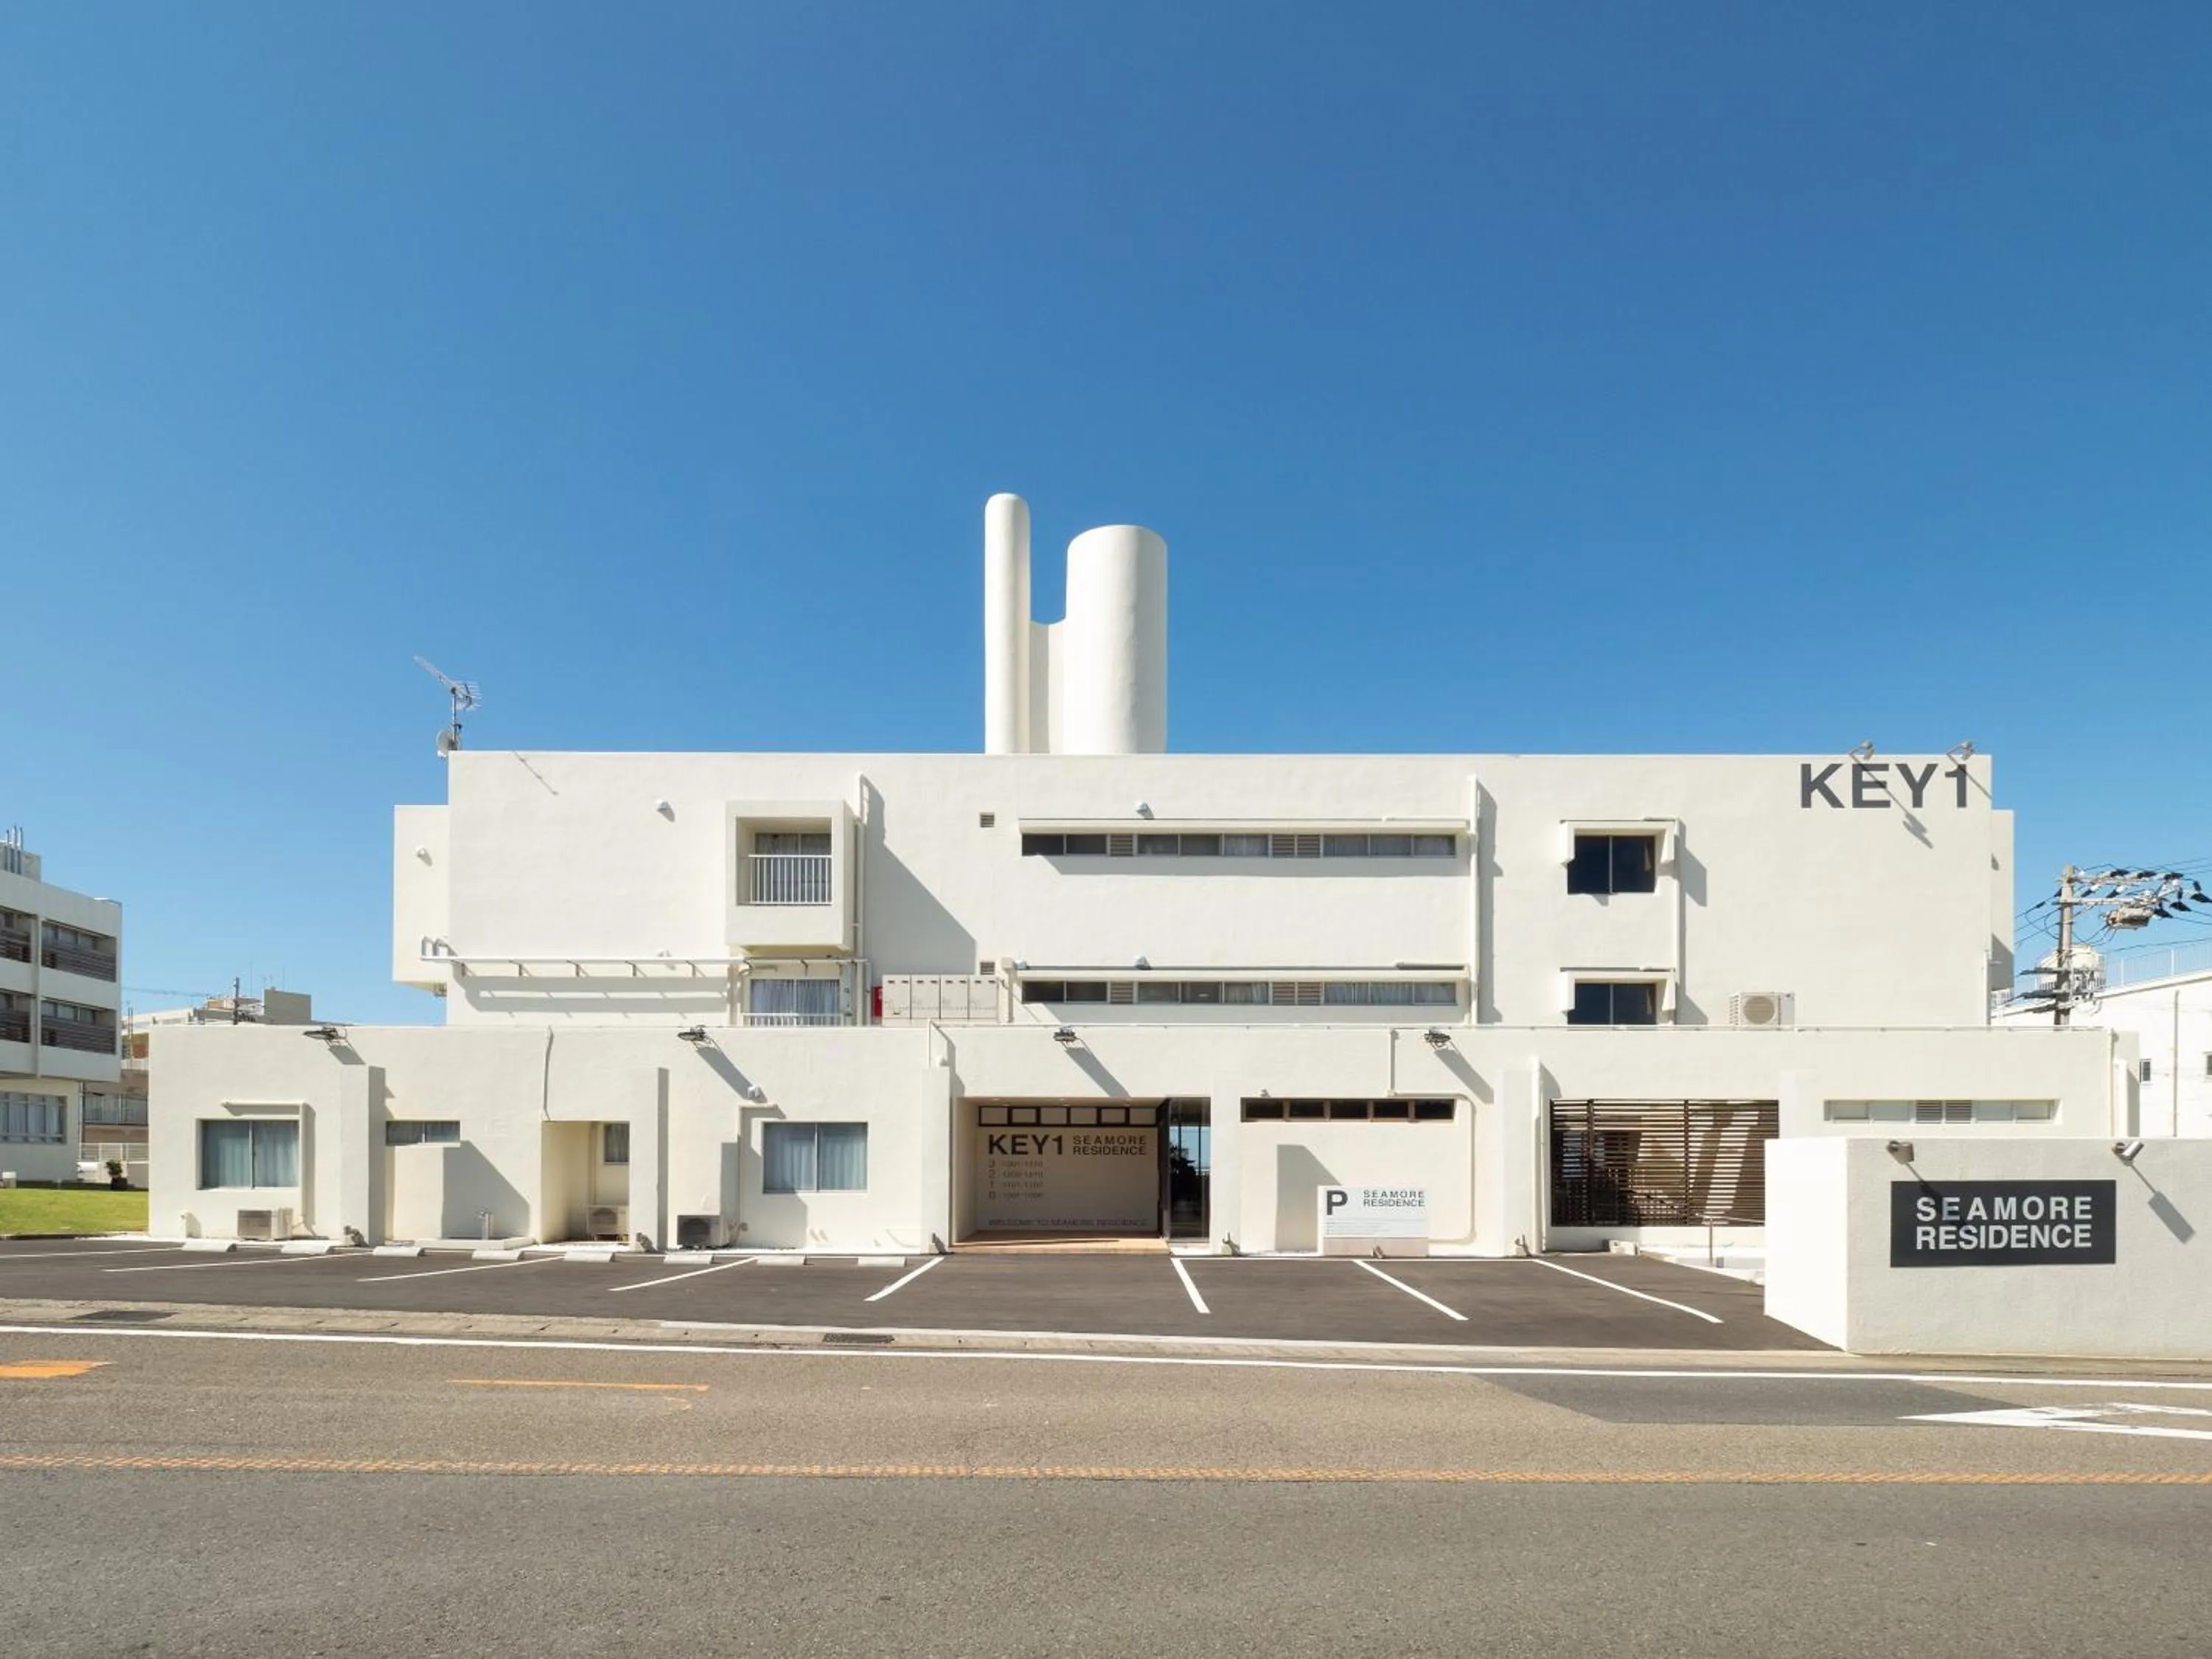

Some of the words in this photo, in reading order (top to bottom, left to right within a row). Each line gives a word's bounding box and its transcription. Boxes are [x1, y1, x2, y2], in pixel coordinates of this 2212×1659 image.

[1801, 763, 1967, 809] KEY1
[988, 1134, 1063, 1155] KEY1
[1073, 1135, 1147, 1145] SEAMORE
[1073, 1146, 1147, 1155] RESIDENCE
[1326, 1190, 1348, 1215] P
[1363, 1190, 1425, 1198] SEAMORE
[1363, 1199, 1425, 1207] RESIDENCE
[1916, 1195, 2093, 1222] SEAMORE
[1916, 1223, 2093, 1250] RESIDENCE
